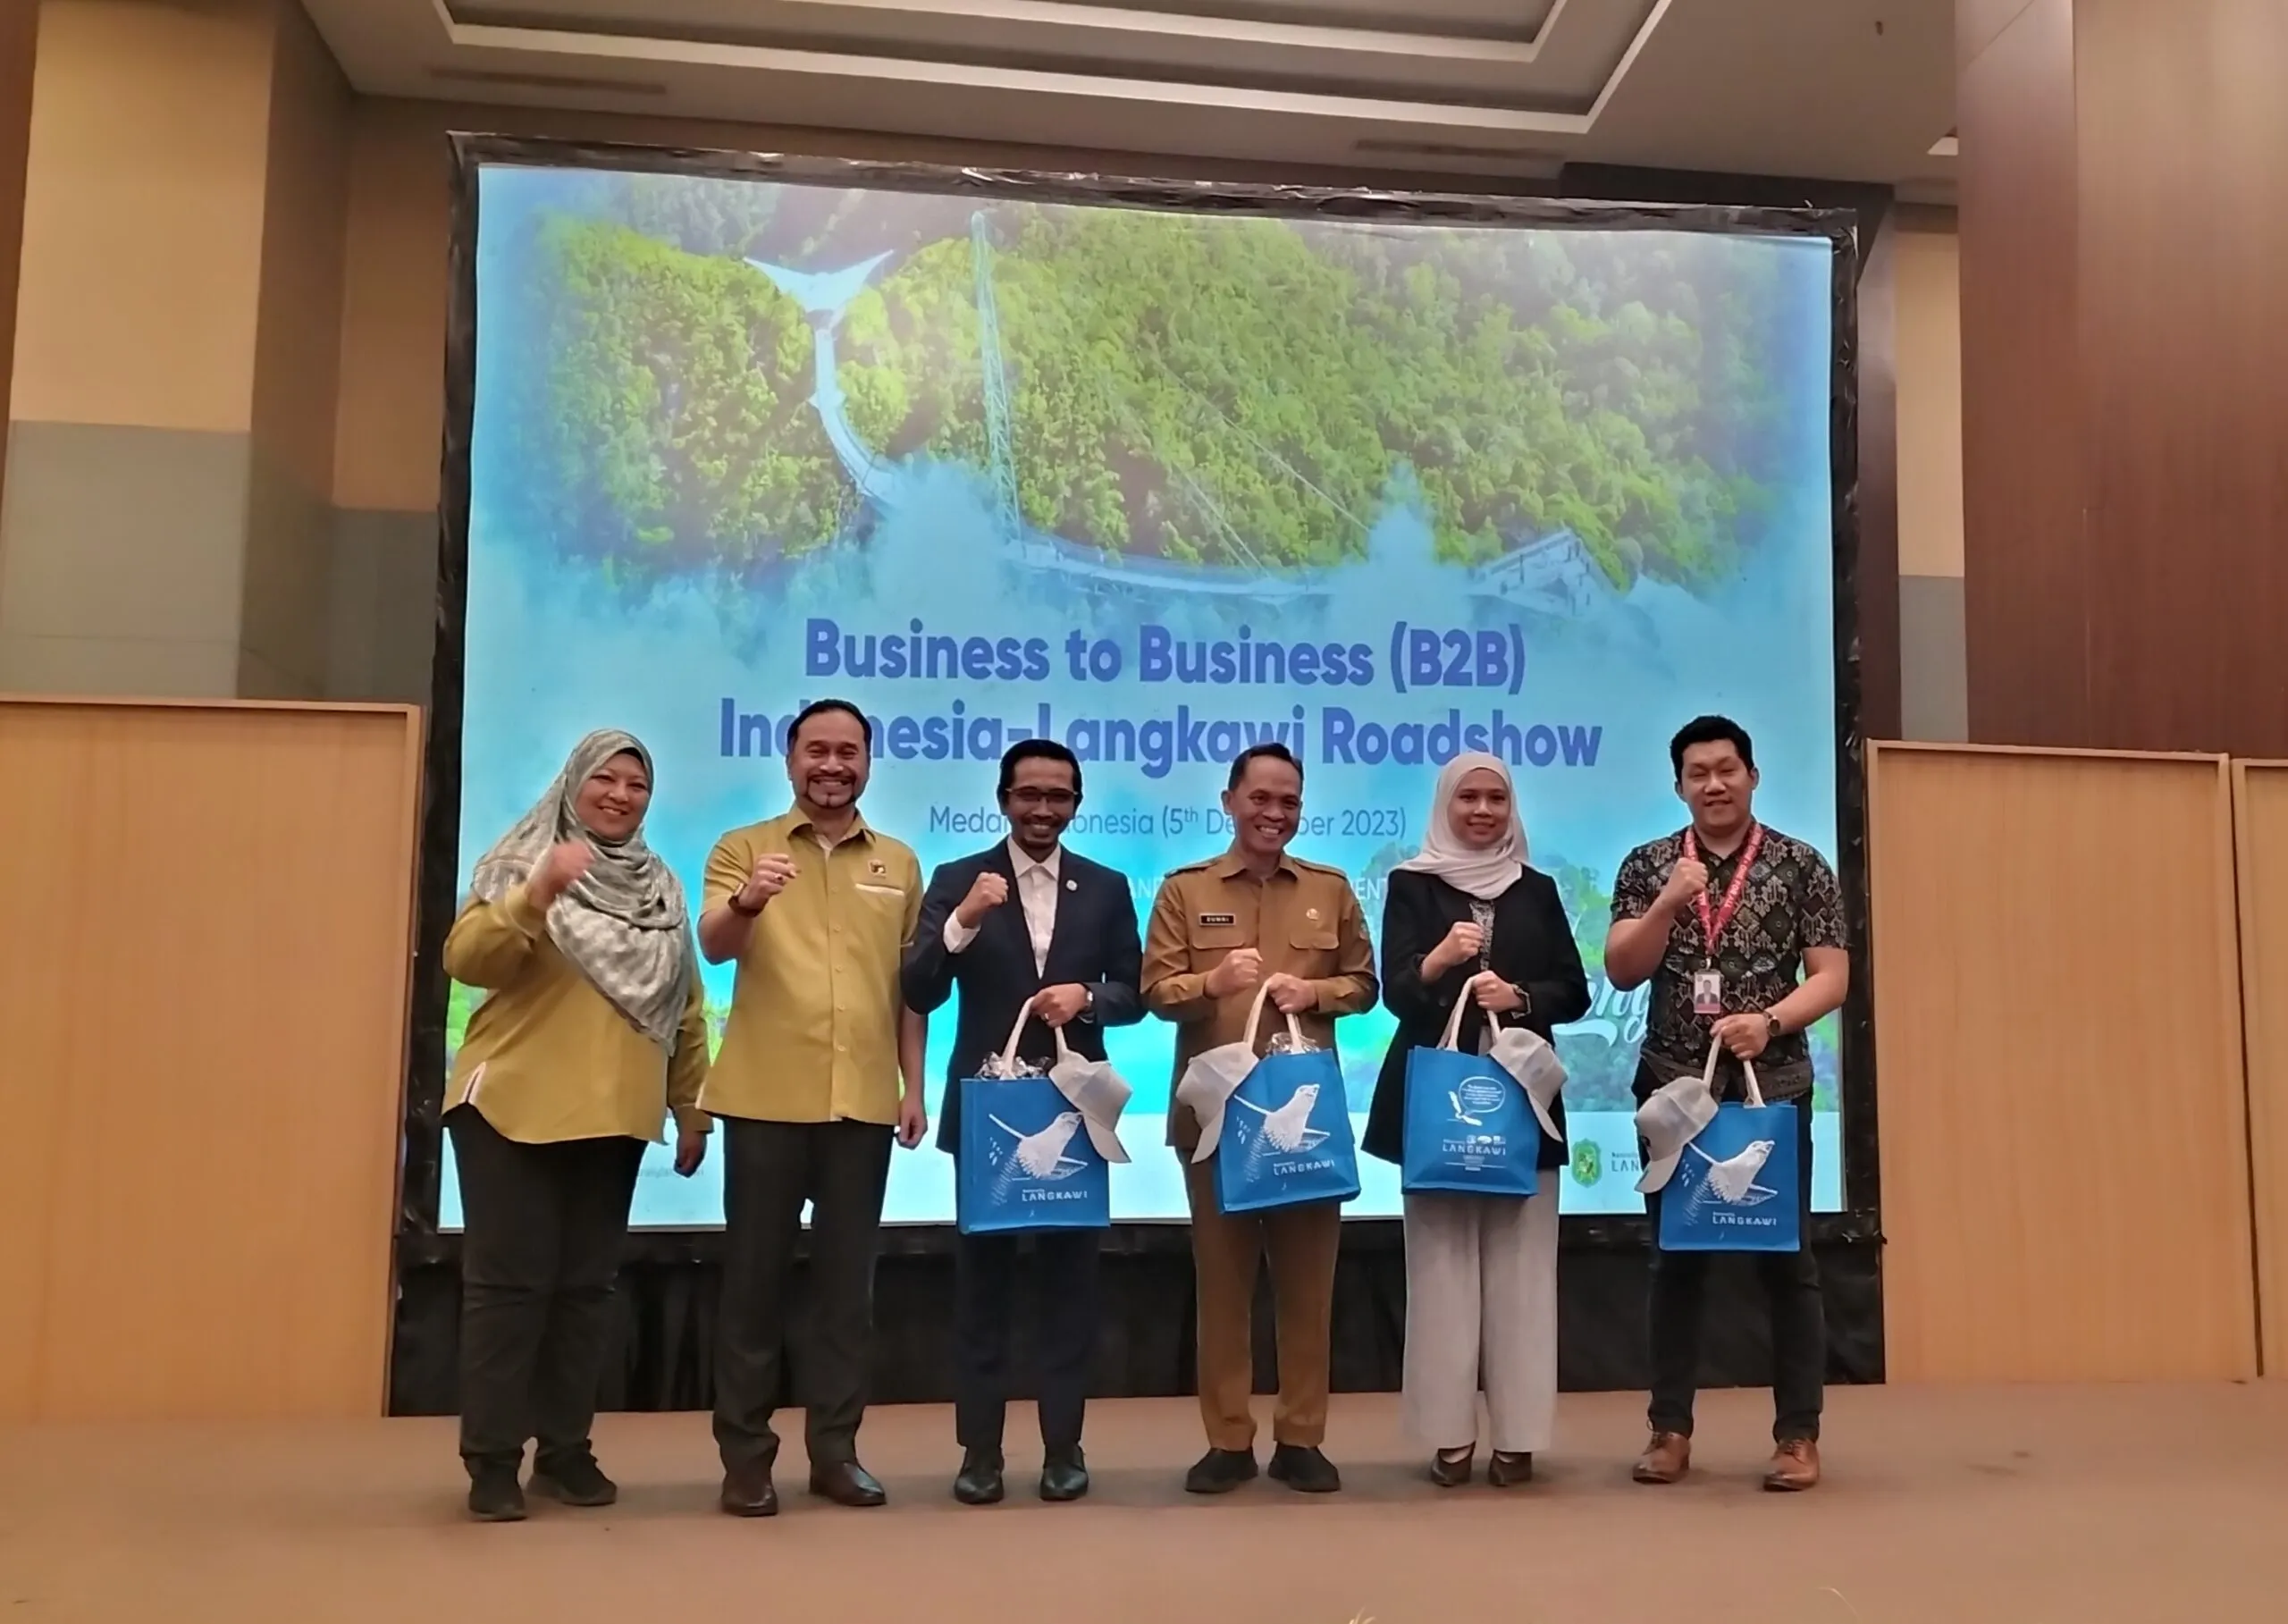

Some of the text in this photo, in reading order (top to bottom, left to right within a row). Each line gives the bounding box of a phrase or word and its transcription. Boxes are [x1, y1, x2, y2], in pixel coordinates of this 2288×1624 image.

[806, 618, 1526, 694] Business to Business (B2B)
[1323, 707, 1603, 767] Roadshow
[1163, 806, 1199, 837] (5th
[1342, 807, 1407, 839] 2023)
[1443, 1143, 1506, 1156] LANGKAWI
[1274, 1159, 1335, 1176] LANGKAWI
[1611, 1159, 1639, 1173] LAN
[1022, 1190, 1088, 1202] LANGKAWI
[1712, 1216, 1777, 1227] LANGKAWI
